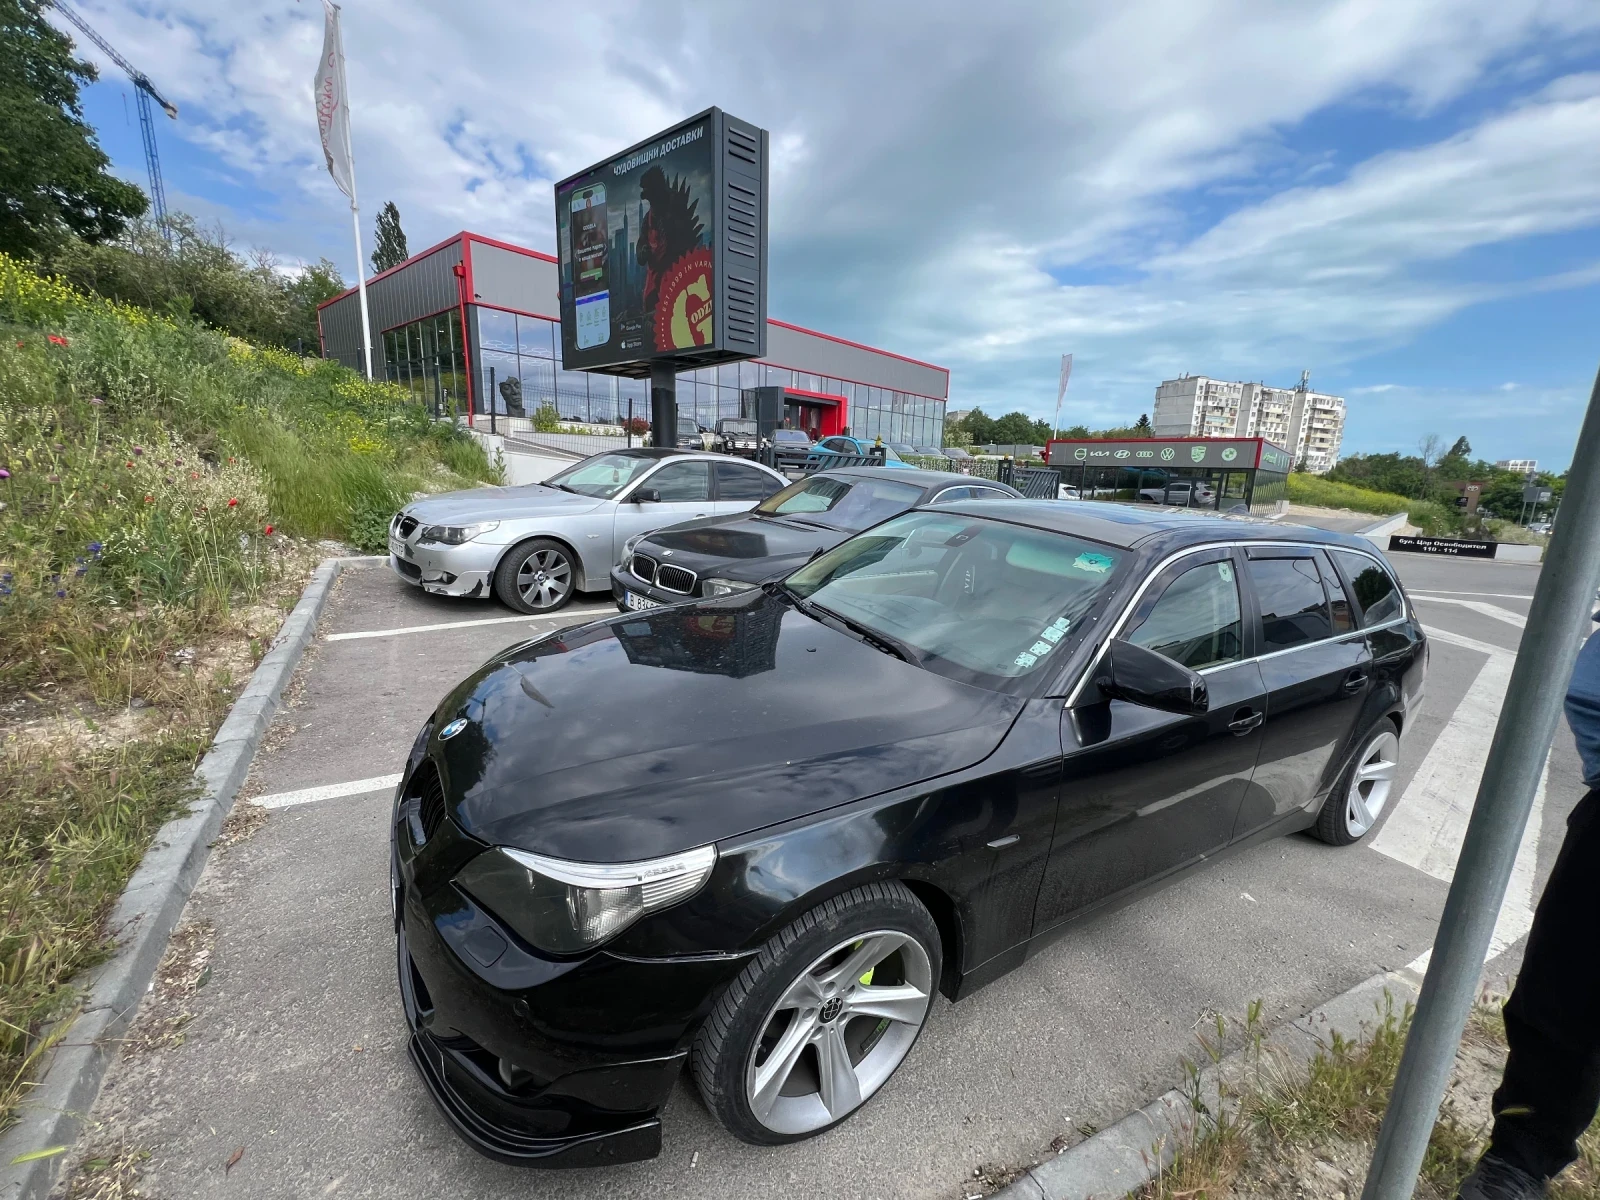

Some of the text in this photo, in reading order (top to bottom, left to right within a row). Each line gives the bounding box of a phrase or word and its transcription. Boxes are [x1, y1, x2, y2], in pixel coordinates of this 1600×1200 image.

[613, 126, 703, 176] ЧУДОВИЩНИ ДОСТАВКИ
[684, 264, 692, 273] IN
[1433, 541, 1487, 550] Освободител
